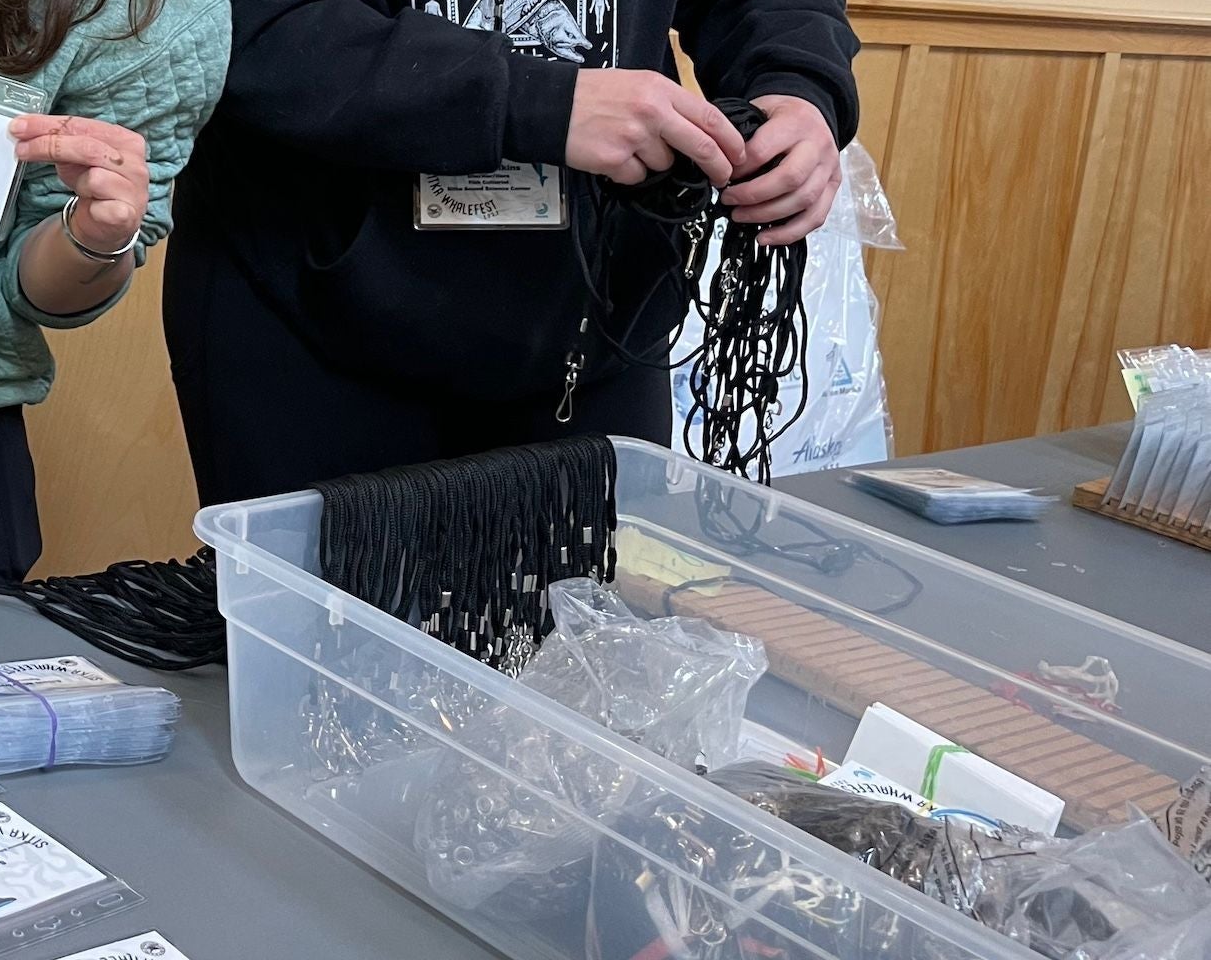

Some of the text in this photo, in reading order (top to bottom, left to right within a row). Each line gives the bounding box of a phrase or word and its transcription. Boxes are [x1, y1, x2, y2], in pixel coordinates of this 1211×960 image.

[427, 174, 499, 216] ITKA WHALEFEST
[9, 828, 49, 849] SITKA
